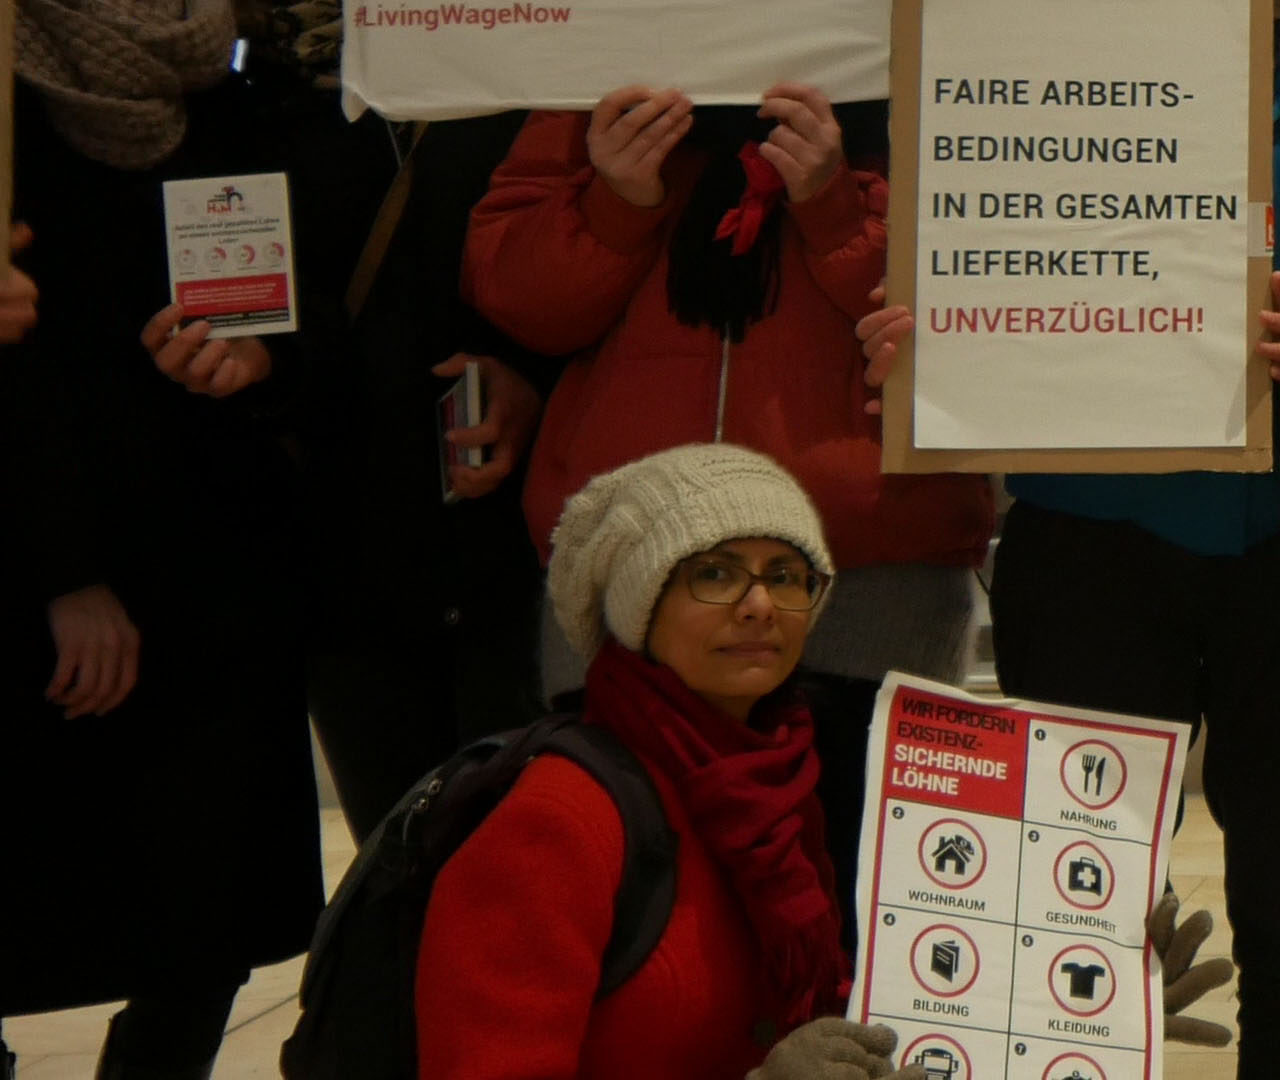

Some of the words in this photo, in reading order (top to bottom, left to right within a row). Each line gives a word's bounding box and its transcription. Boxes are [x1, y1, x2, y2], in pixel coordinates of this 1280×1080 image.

[354, 3, 570, 32] #LivingWageNow
[934, 78, 1030, 106] FAIRE
[1040, 80, 1195, 108] ARBEITS-
[933, 135, 1178, 164] BEDINGUNGEN
[932, 193, 966, 218] IN
[979, 193, 1044, 219] DER
[1055, 193, 1238, 220] GESAMTEN
[930, 250, 1160, 281] LIEFERKETTE,
[929, 301, 1204, 334] UNVERZÜGLICH!
[902, 696, 935, 721] WIR
[935, 705, 1016, 735] FORDERN
[896, 720, 983, 750] EXISTENZ-
[894, 744, 1007, 780] SICHERNDE
[892, 767, 959, 795] LÖHNE
[1060, 809, 1117, 831] NAHRUNG
[908, 889, 985, 912] WOHNRAUM
[1045, 911, 1116, 934] GESUNDHEIT
[912, 999, 969, 1017] BILDUNG
[1048, 1019, 1110, 1037] KLEIDUNG
